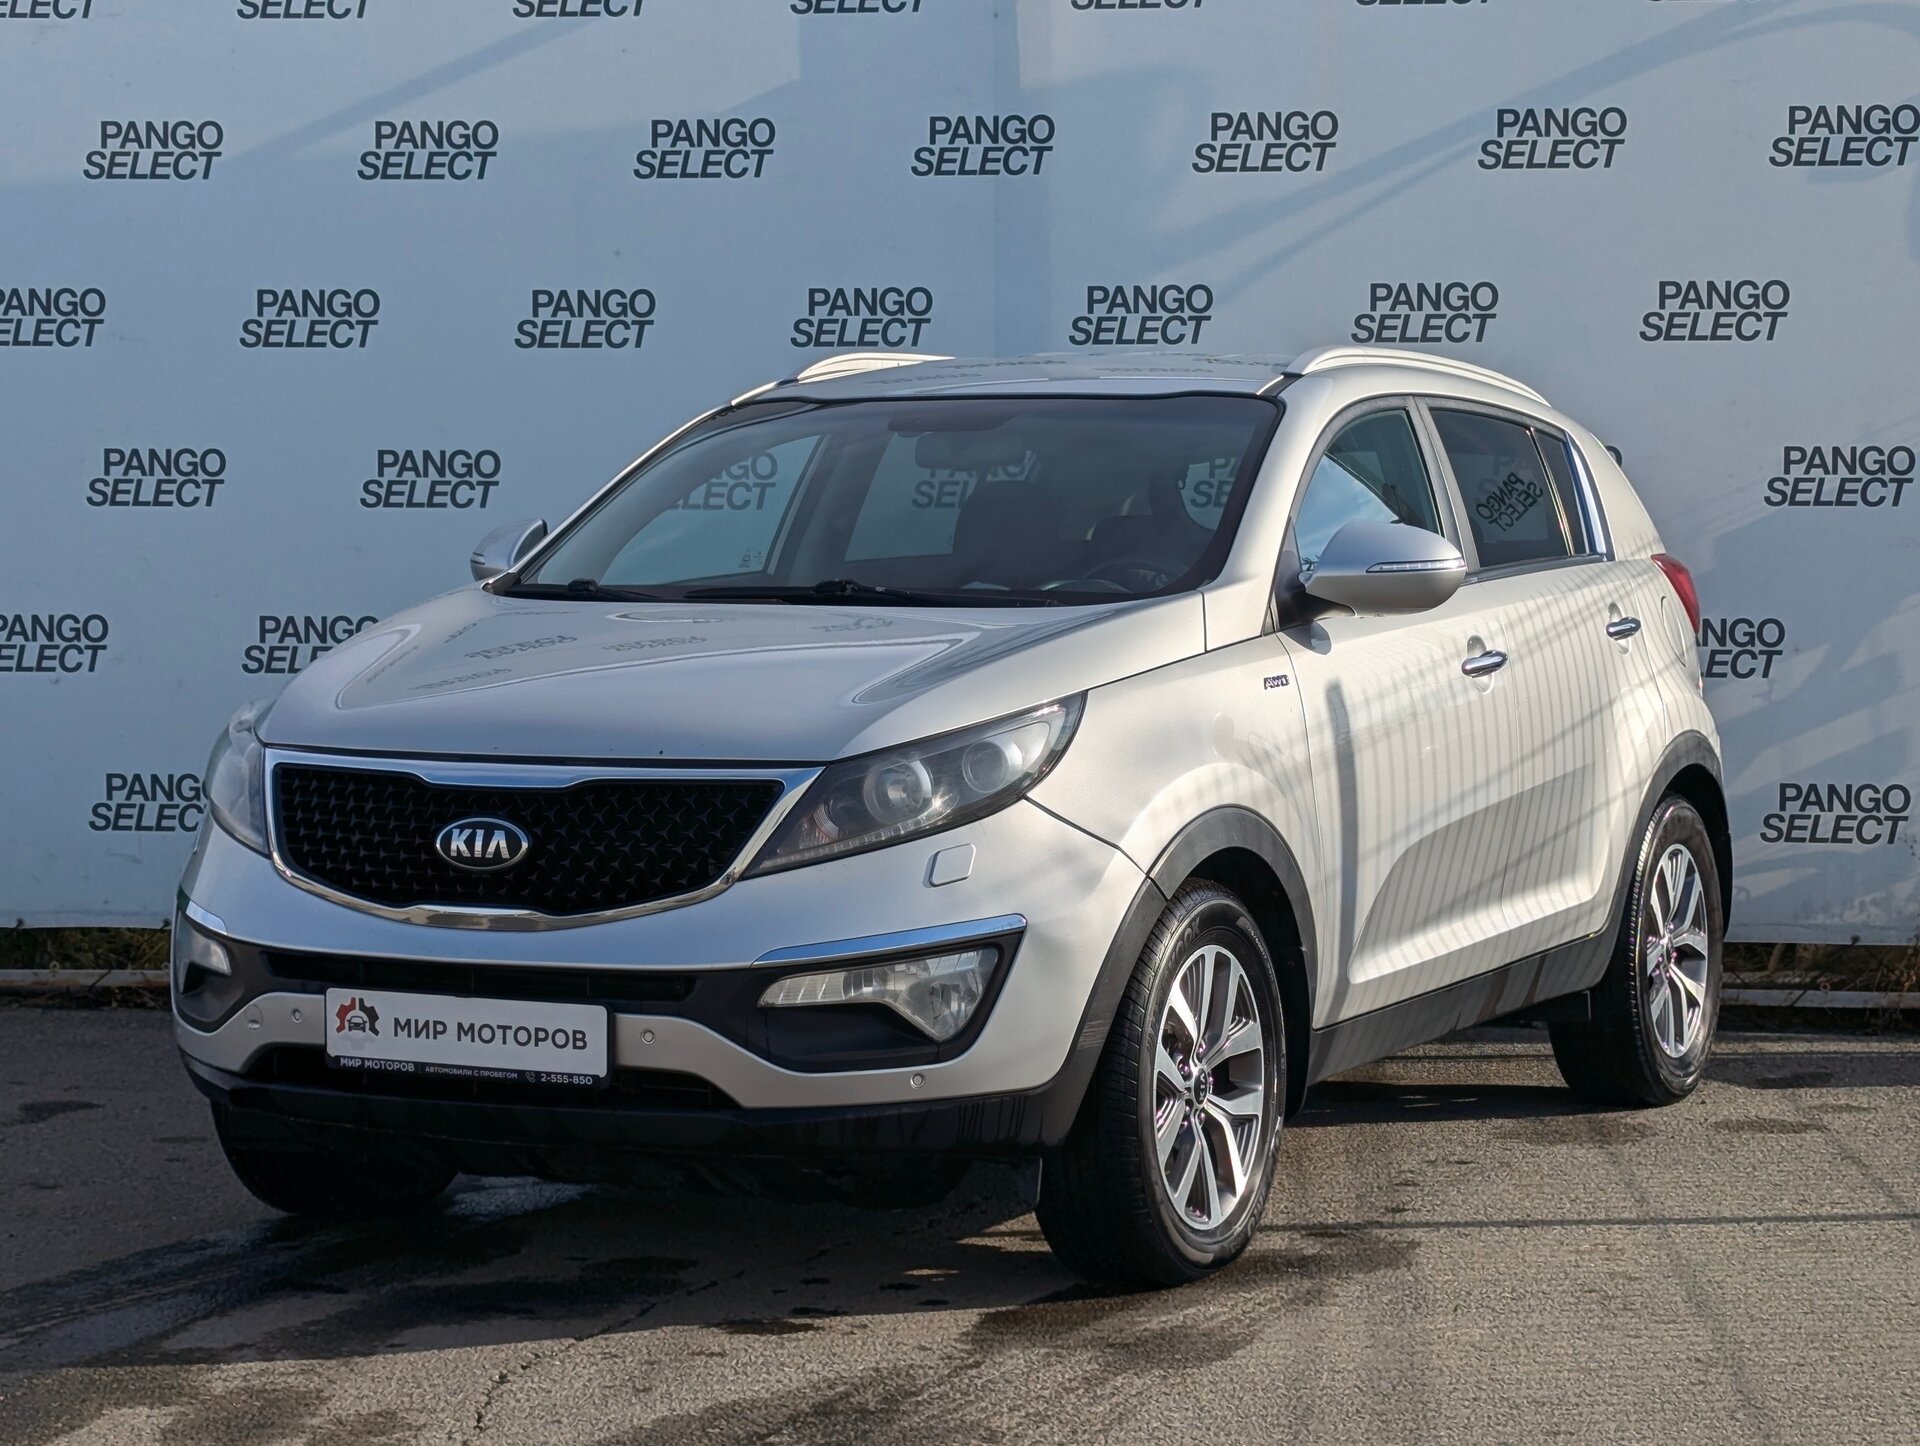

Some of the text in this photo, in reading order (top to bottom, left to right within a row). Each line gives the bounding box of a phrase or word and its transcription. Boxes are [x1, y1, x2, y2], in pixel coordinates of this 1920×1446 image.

[237, 0, 366, 19] SELECT
[652, 118, 775, 148] PANGO
[930, 115, 1055, 145] PANGO
[1211, 111, 1338, 141] PANGO
[1497, 107, 1627, 137] PANGO
[1789, 104, 1920, 134] PANGO
[101, 121, 223, 149] PANGO
[375, 120, 498, 149] PANGO
[83, 151, 222, 180] SELECT
[358, 151, 497, 180] SELECT
[634, 149, 774, 179] SELECT
[911, 146, 1053, 176] SELECT
[1192, 142, 1336, 173] SELECT
[1478, 139, 1625, 169] SELECT
[1769, 136, 1919, 167] SELECT
[0, 288, 106, 317] ANGO
[257, 289, 380, 318] PANGO
[532, 289, 655, 318] PANGO
[809, 287, 932, 316] PANGO
[1088, 284, 1213, 314] PANGO
[1370, 282, 1498, 312] PANGO
[1659, 280, 1789, 310] PANGO
[0, 318, 104, 347] ELECT
[240, 319, 378, 348] SELECT
[515, 319, 654, 348] SELECT
[791, 318, 931, 347] SELECT
[1069, 315, 1211, 345] SELECT
[1351, 313, 1496, 343] SELECT
[1640, 311, 1788, 341] SELECT
[104, 448, 226, 477] PANGO
[378, 450, 501, 479] PANGO
[1784, 446, 1915, 476] PANGO
[87, 478, 224, 507] SELECT
[360, 480, 499, 508] SELECT
[1764, 477, 1914, 508] SELECT
[1695, 618, 1785, 648] NGO
[0, 644, 107, 672] ELECT
[1701, 649, 1783, 679] ECT
[106, 773, 208, 802] PANG
[1779, 783, 1910, 814] PANGO
[89, 803, 207, 832] SELEC
[1760, 814, 1909, 844] SELECT
[450, 828, 510, 859] KIA
[393, 1017, 588, 1051] МИР МОТОРОВ
[340, 1058, 415, 1072] МИР МОТОРОВ
[425, 1066, 473, 1076] АВТОМОБИЛИ
[480, 1069, 518, 1079] ПРОБЕГОМ
[540, 1073, 593, 1085] 2-555-850
